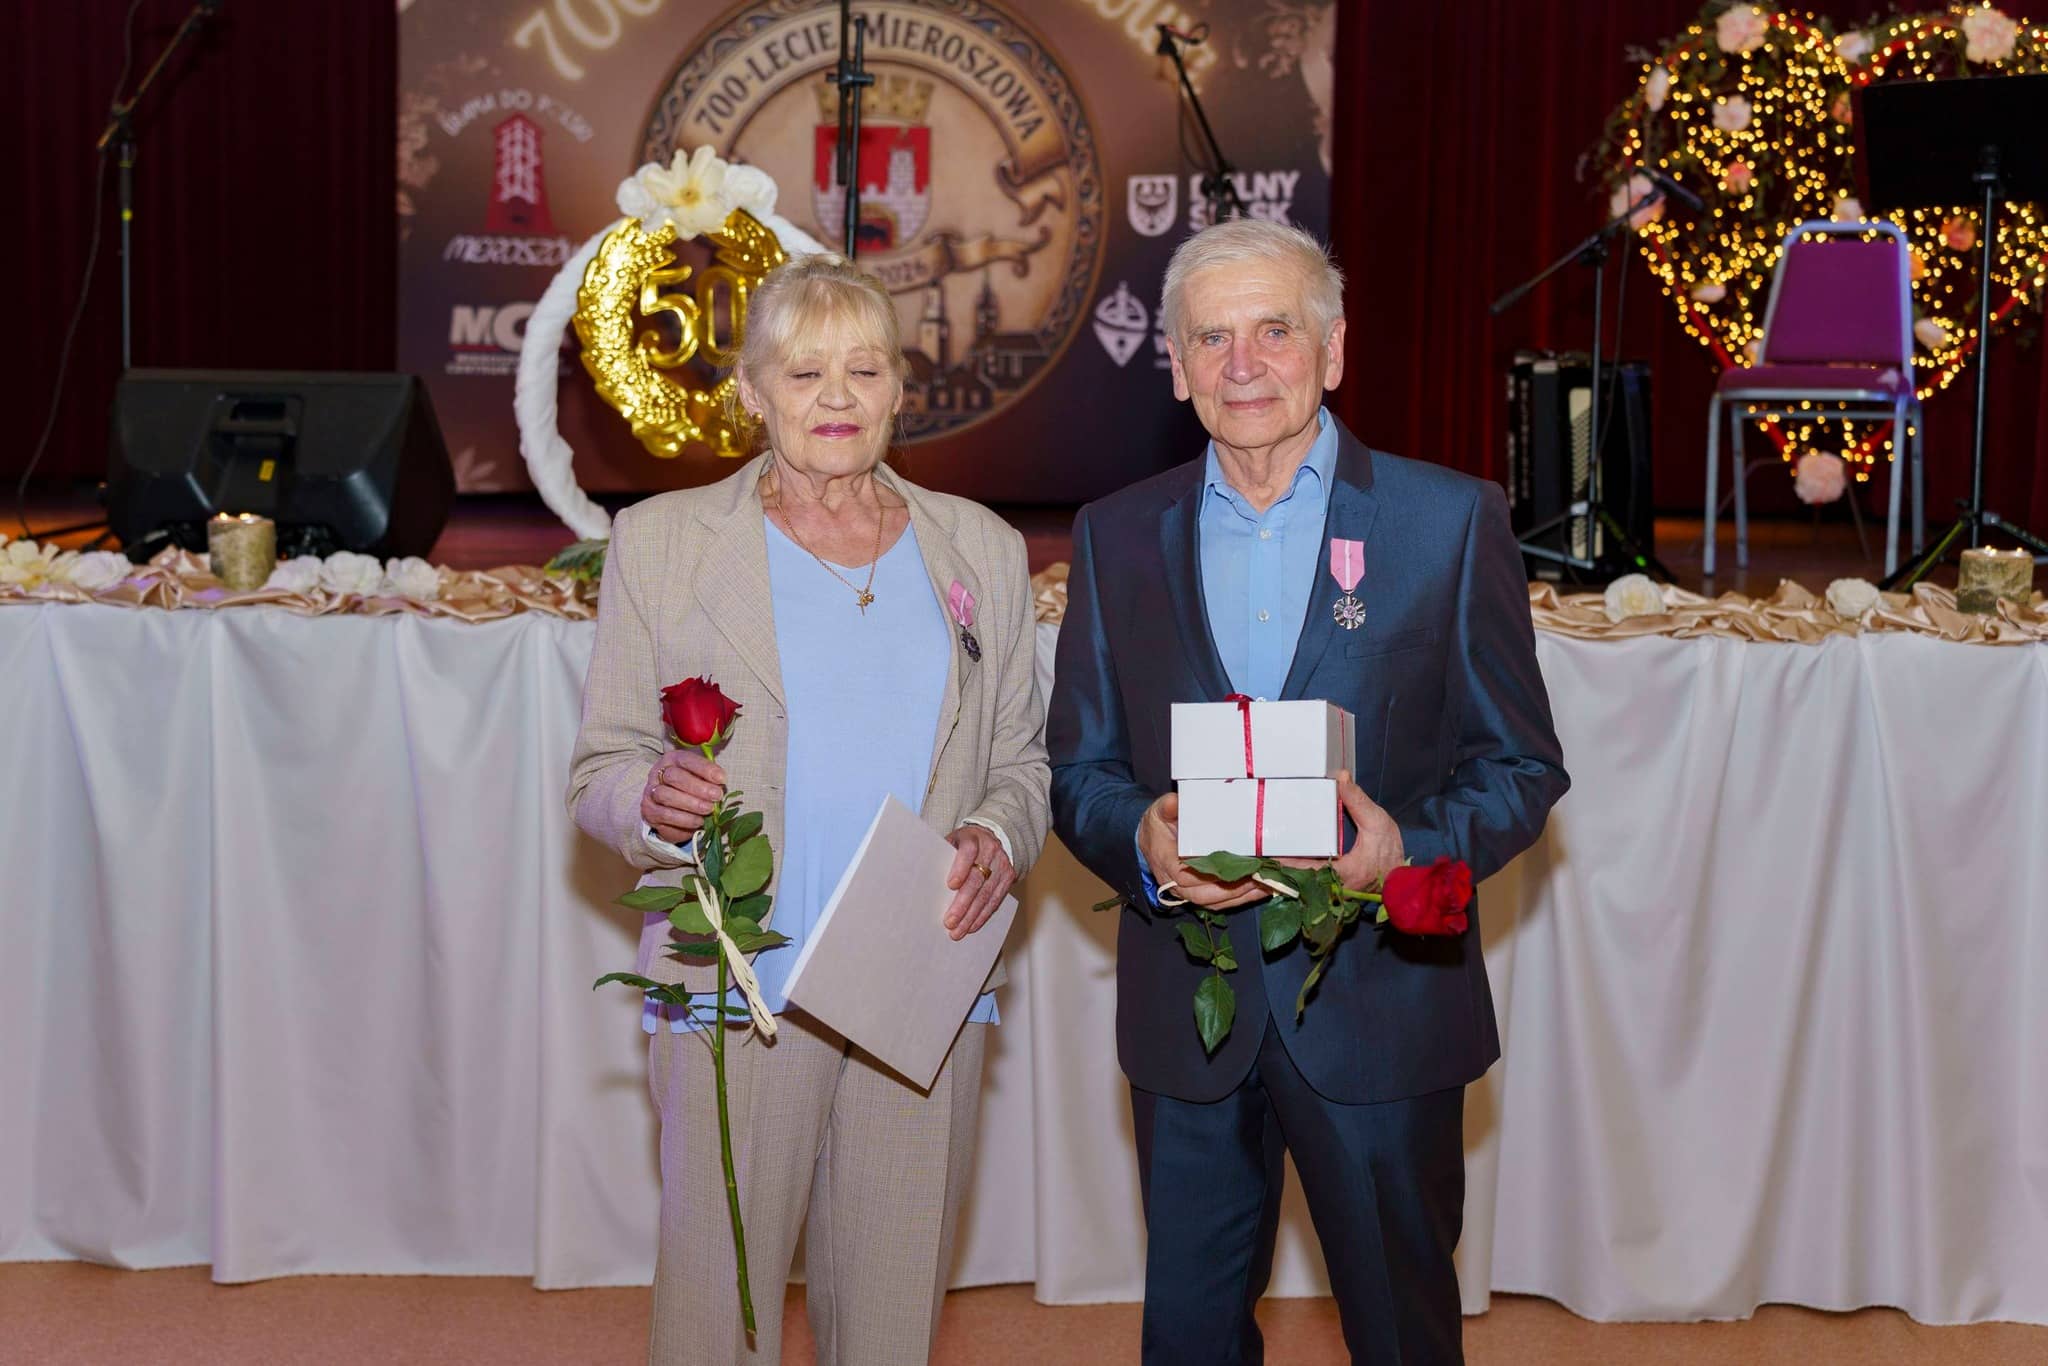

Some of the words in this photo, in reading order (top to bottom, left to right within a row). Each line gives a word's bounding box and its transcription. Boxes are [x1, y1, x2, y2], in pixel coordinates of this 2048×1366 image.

[695, 21, 837, 135] 700-LECIE
[854, 12, 1044, 140] MIEROSZOWA
[639, 265, 748, 368] 50
